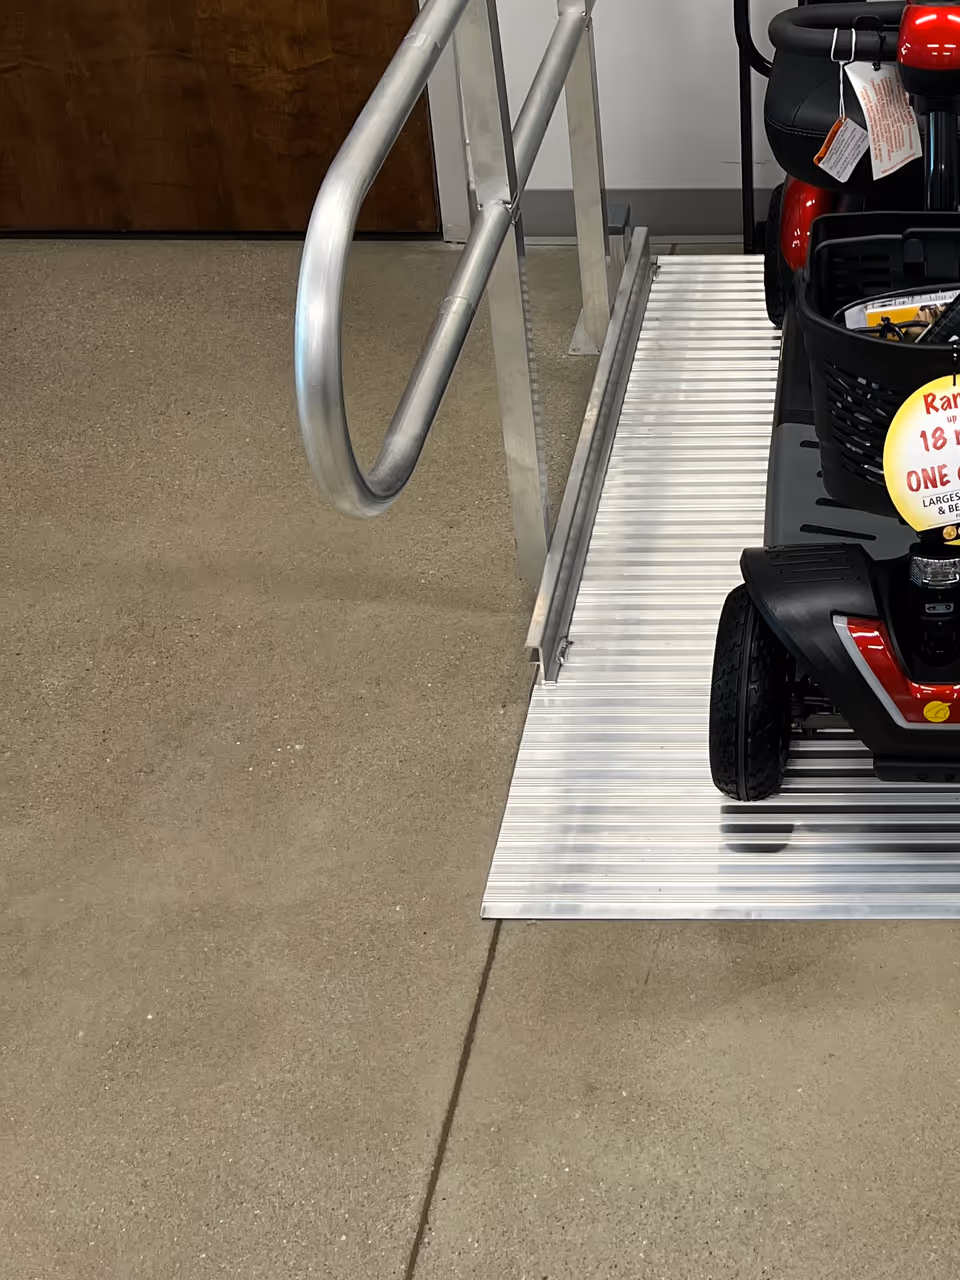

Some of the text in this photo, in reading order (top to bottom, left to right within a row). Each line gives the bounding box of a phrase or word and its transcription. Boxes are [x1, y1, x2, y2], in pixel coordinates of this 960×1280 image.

[946, 416, 957, 425] up
[919, 426, 948, 453] 18
[906, 463, 951, 493] ONE
[937, 505, 946, 515] &
